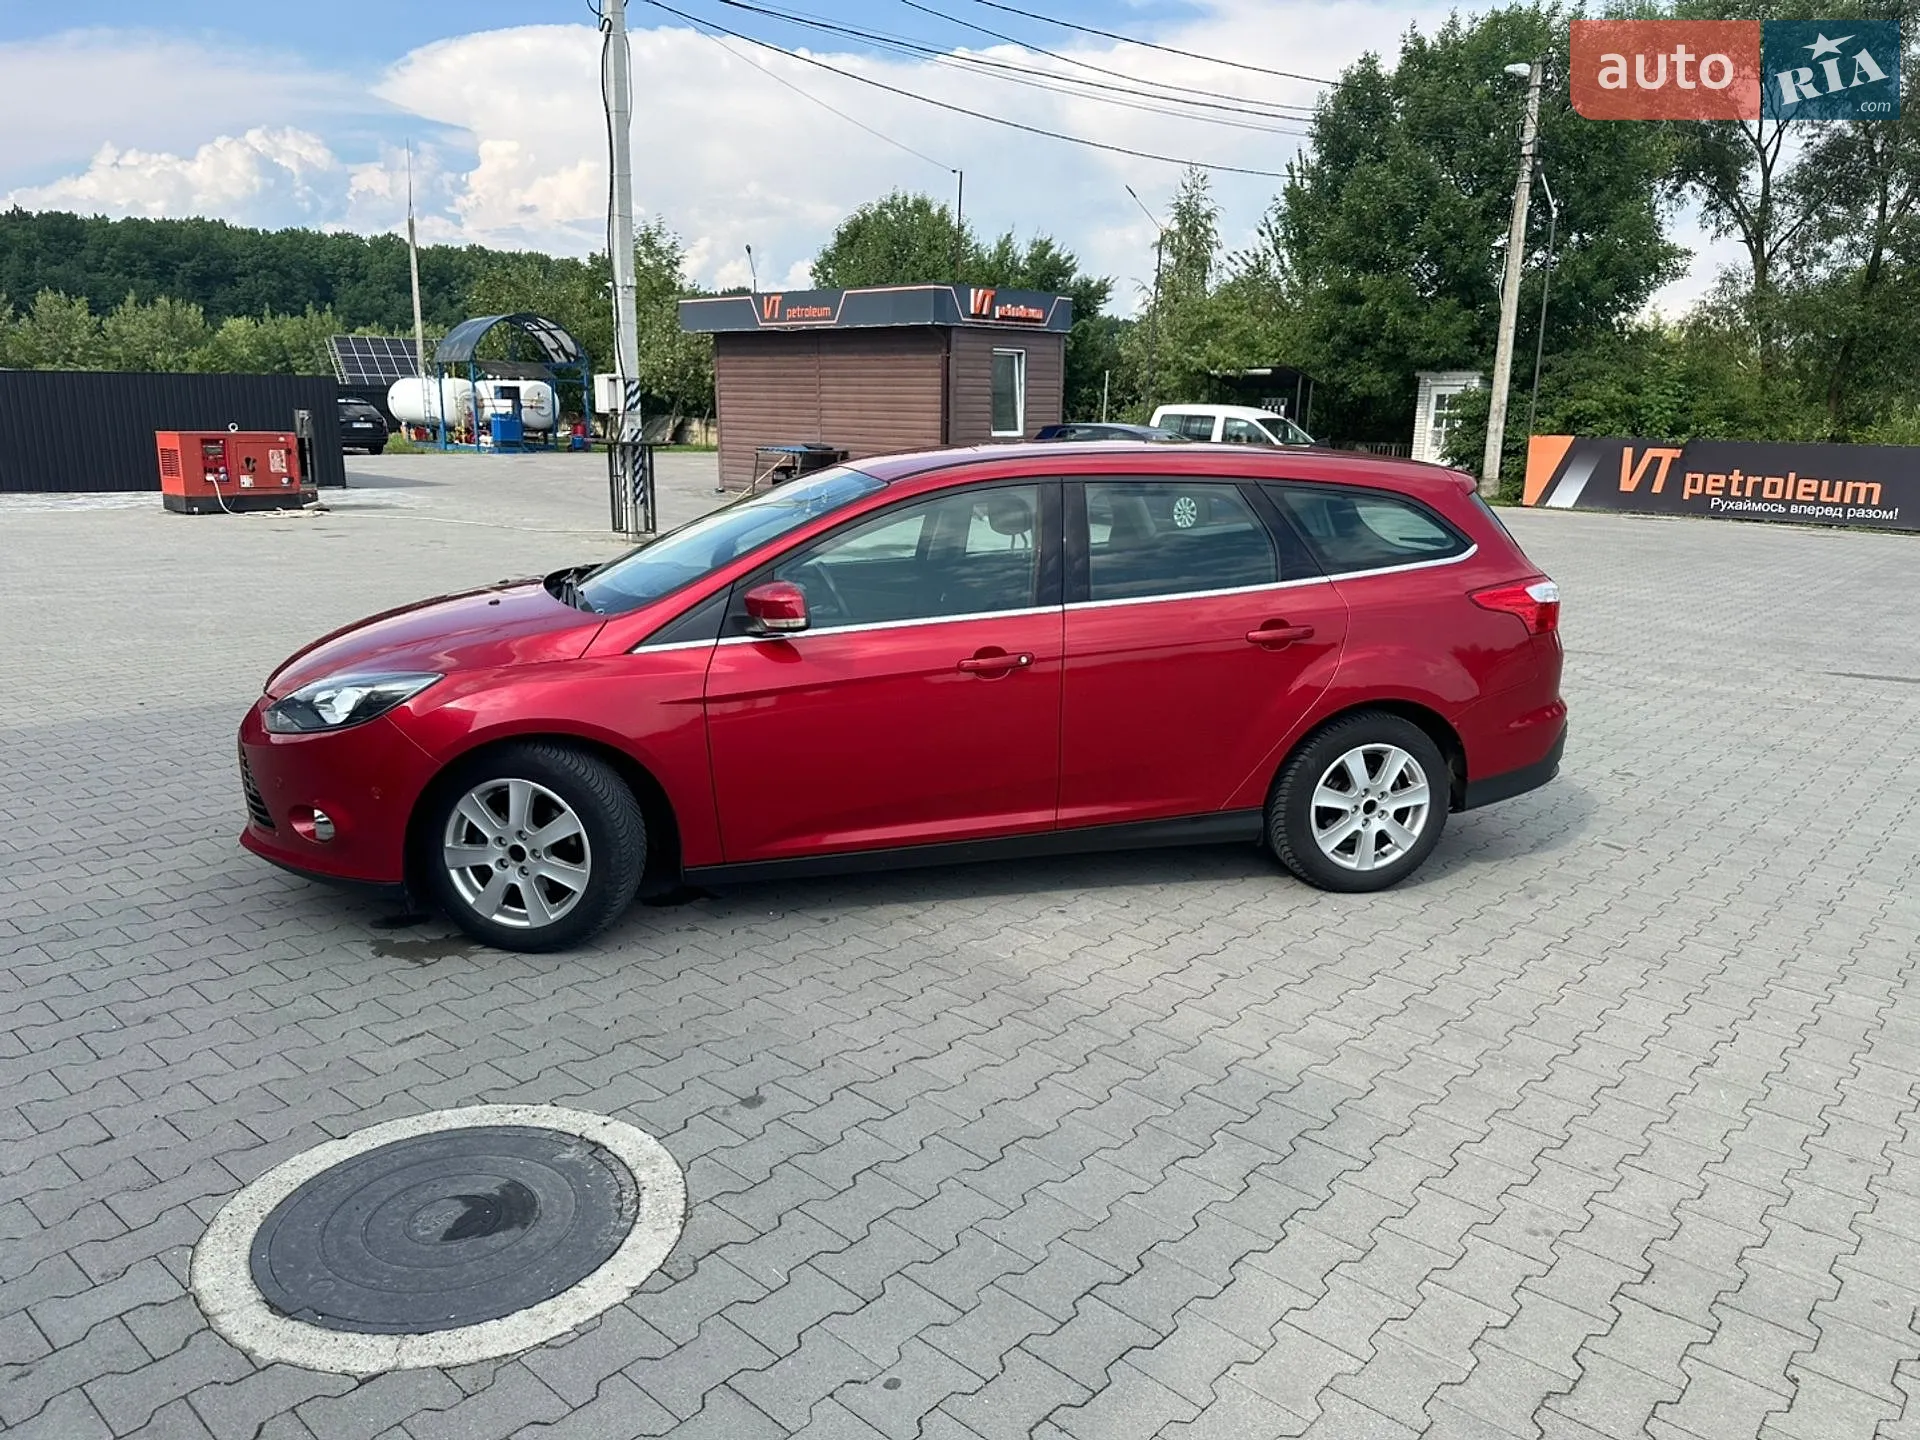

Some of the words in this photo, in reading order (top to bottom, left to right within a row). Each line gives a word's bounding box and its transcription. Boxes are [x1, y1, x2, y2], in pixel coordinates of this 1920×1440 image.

[763, 295, 782, 319] VT
[786, 305, 831, 321] petroleum
[970, 288, 996, 315] VT
[1618, 446, 1682, 494] VT
[1682, 469, 1882, 506] petroleum
[1710, 497, 1786, 514] Рухаймось
[1790, 504, 1843, 518] вперед
[1846, 507, 1899, 520] разом!
